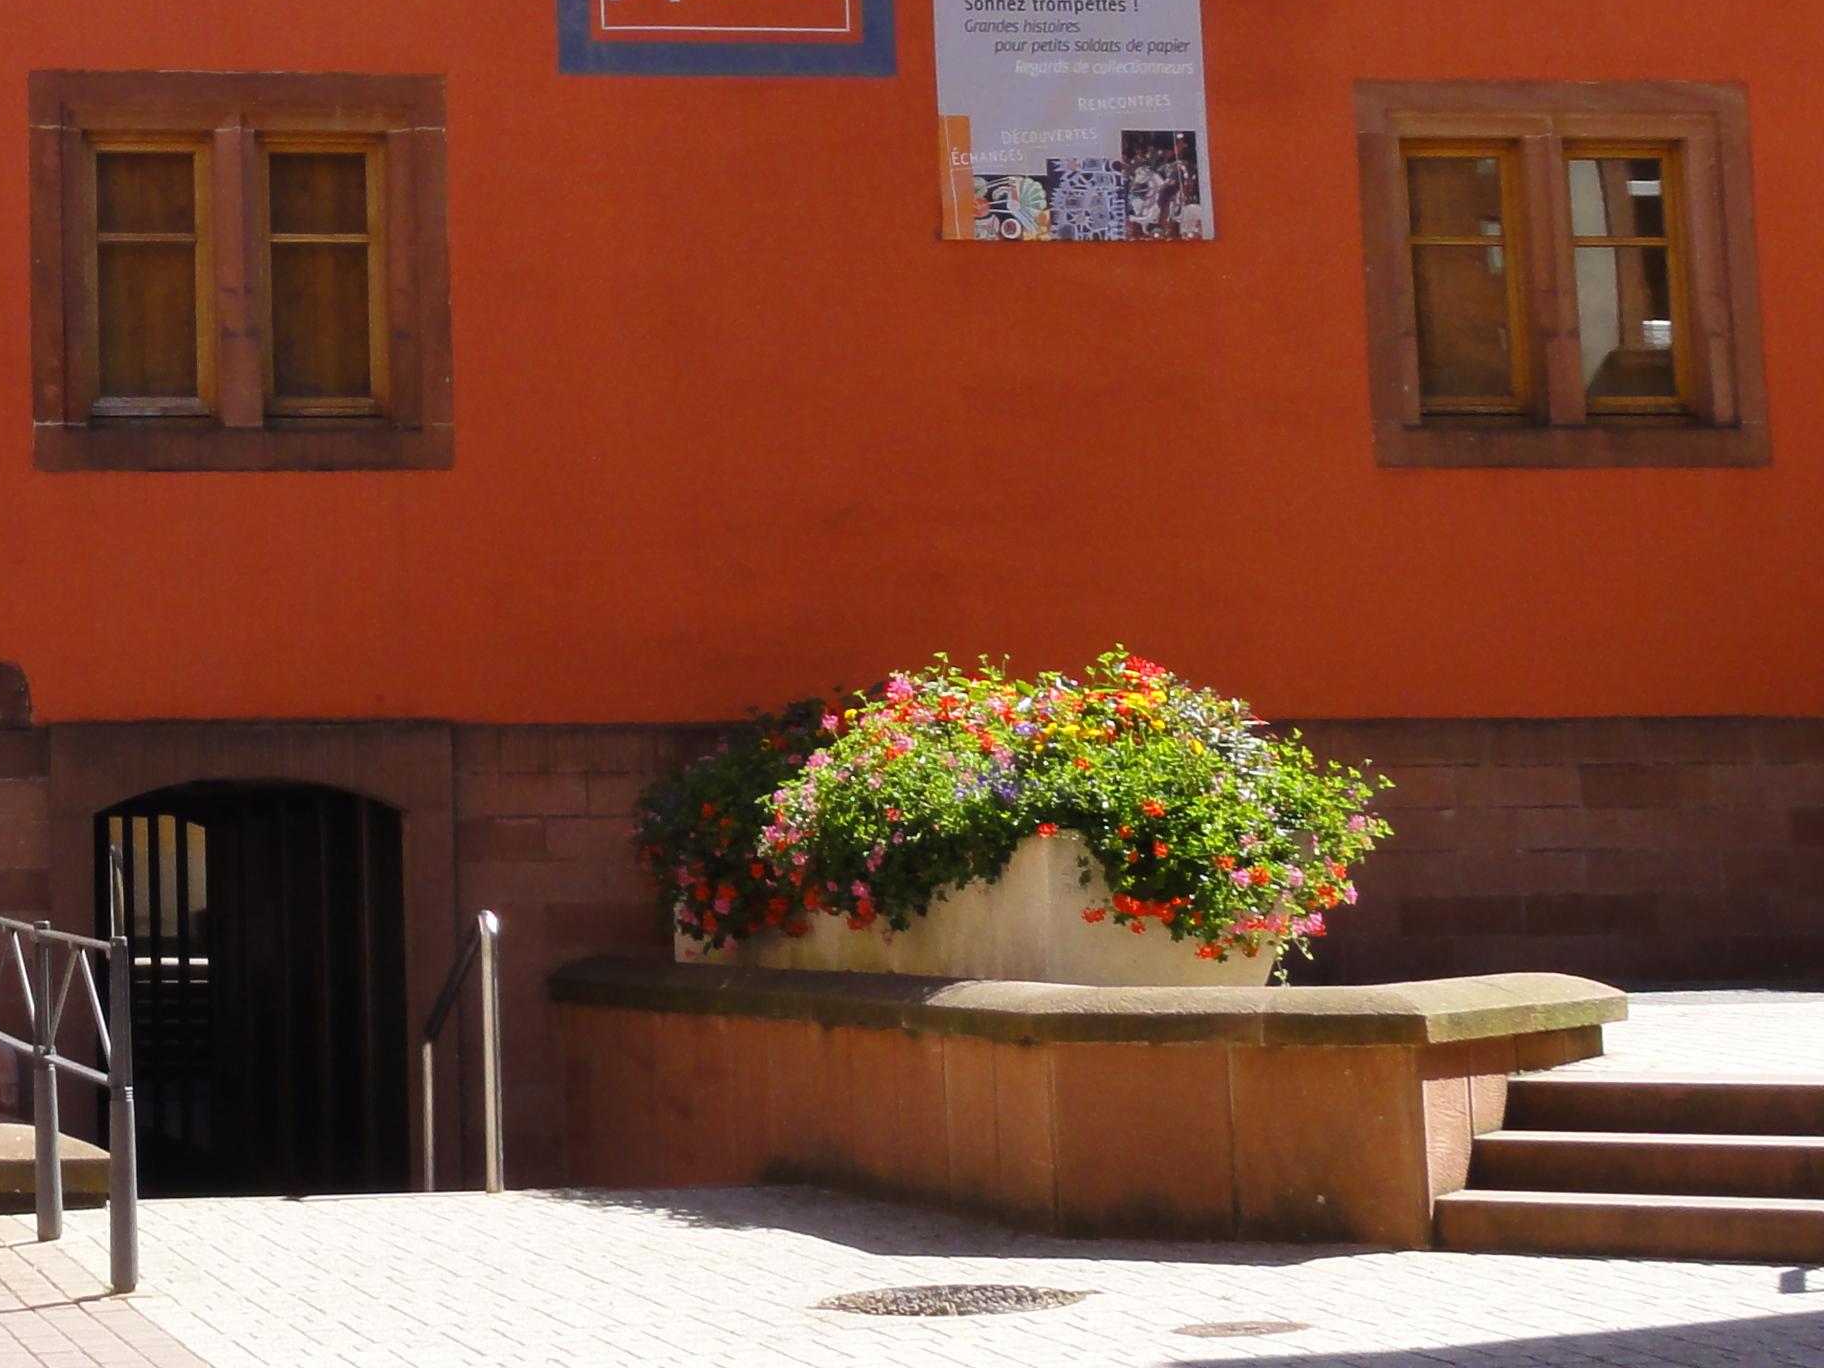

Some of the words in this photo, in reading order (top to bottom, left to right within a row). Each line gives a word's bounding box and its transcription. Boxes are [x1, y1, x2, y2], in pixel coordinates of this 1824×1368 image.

[964, 18, 1019, 33] Grandes
[1023, 18, 1081, 33] histoires
[994, 40, 1028, 54] pour
[1031, 38, 1070, 55] petits
[1074, 38, 1122, 53] soldats
[1125, 38, 1144, 53] de
[1147, 38, 1191, 55] papier
[1015, 59, 1070, 77] Regards
[1073, 59, 1089, 74] de
